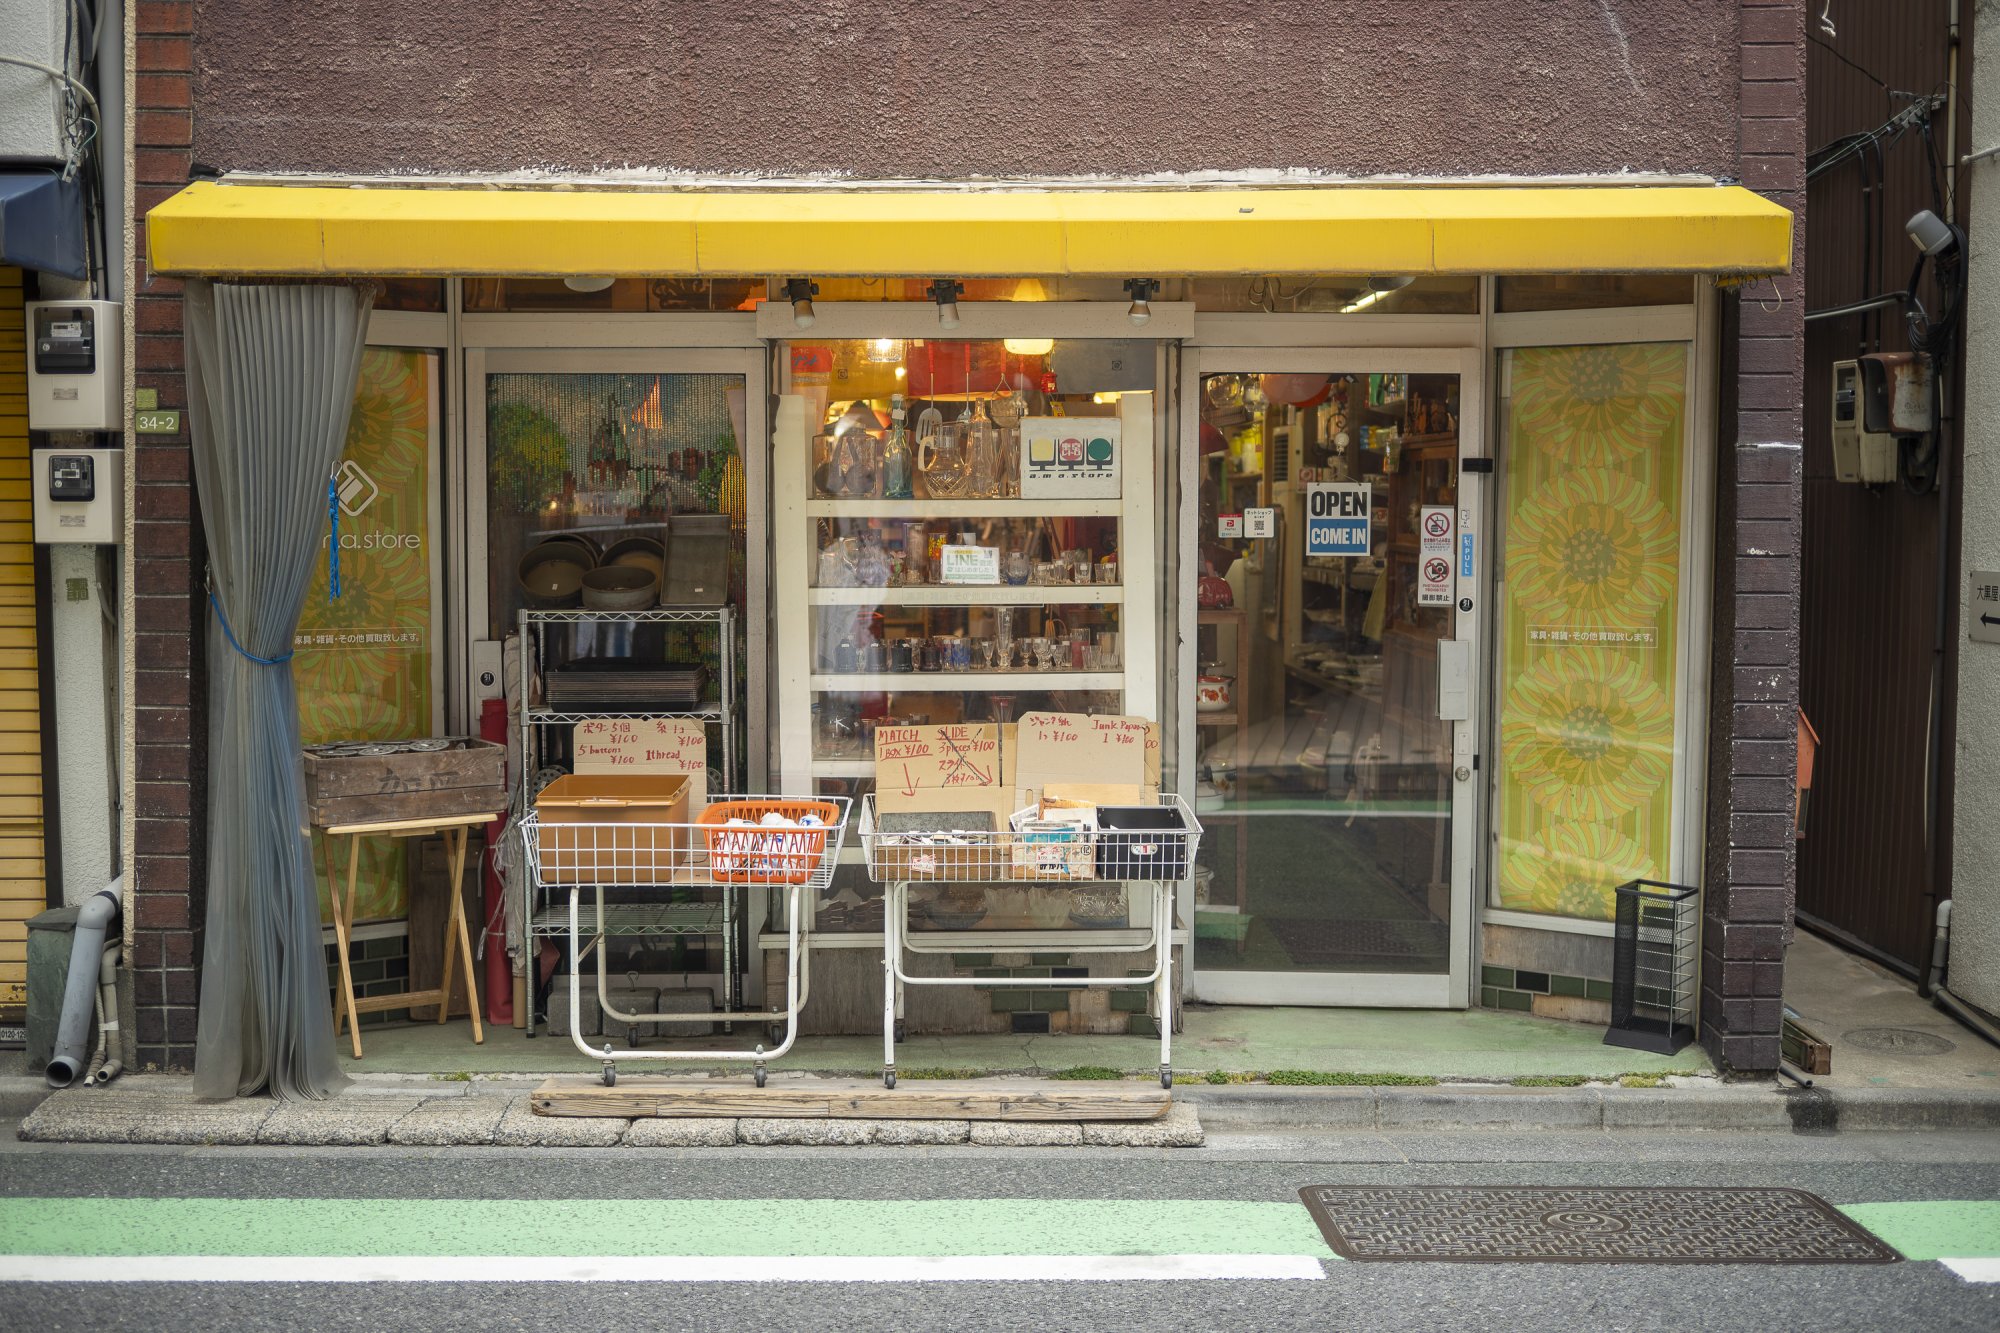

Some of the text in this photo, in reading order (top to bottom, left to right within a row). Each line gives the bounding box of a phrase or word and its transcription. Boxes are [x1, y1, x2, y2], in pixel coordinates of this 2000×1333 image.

[139, 416, 175, 430] 34-2
[1311, 491, 1368, 517] OPEN
[1311, 527, 1367, 545] COME IN
[946, 554, 978, 566] LINE
[1421, 594, 1450, 602] 撮影禁止
[1090, 719, 1118, 730] Junk
[610, 733, 639, 745] ¥100
[878, 729, 920, 744] MATCH
[937, 726, 969, 740] SLIDE
[1053, 730, 1078, 742] ¥100
[677, 735, 705, 747] ¥100
[972, 740, 995, 752] ¥100
[578, 744, 588, 756] 5
[904, 744, 929, 755] ¥100
[610, 755, 635, 765] ¥100
[679, 759, 705, 771] ¥100
